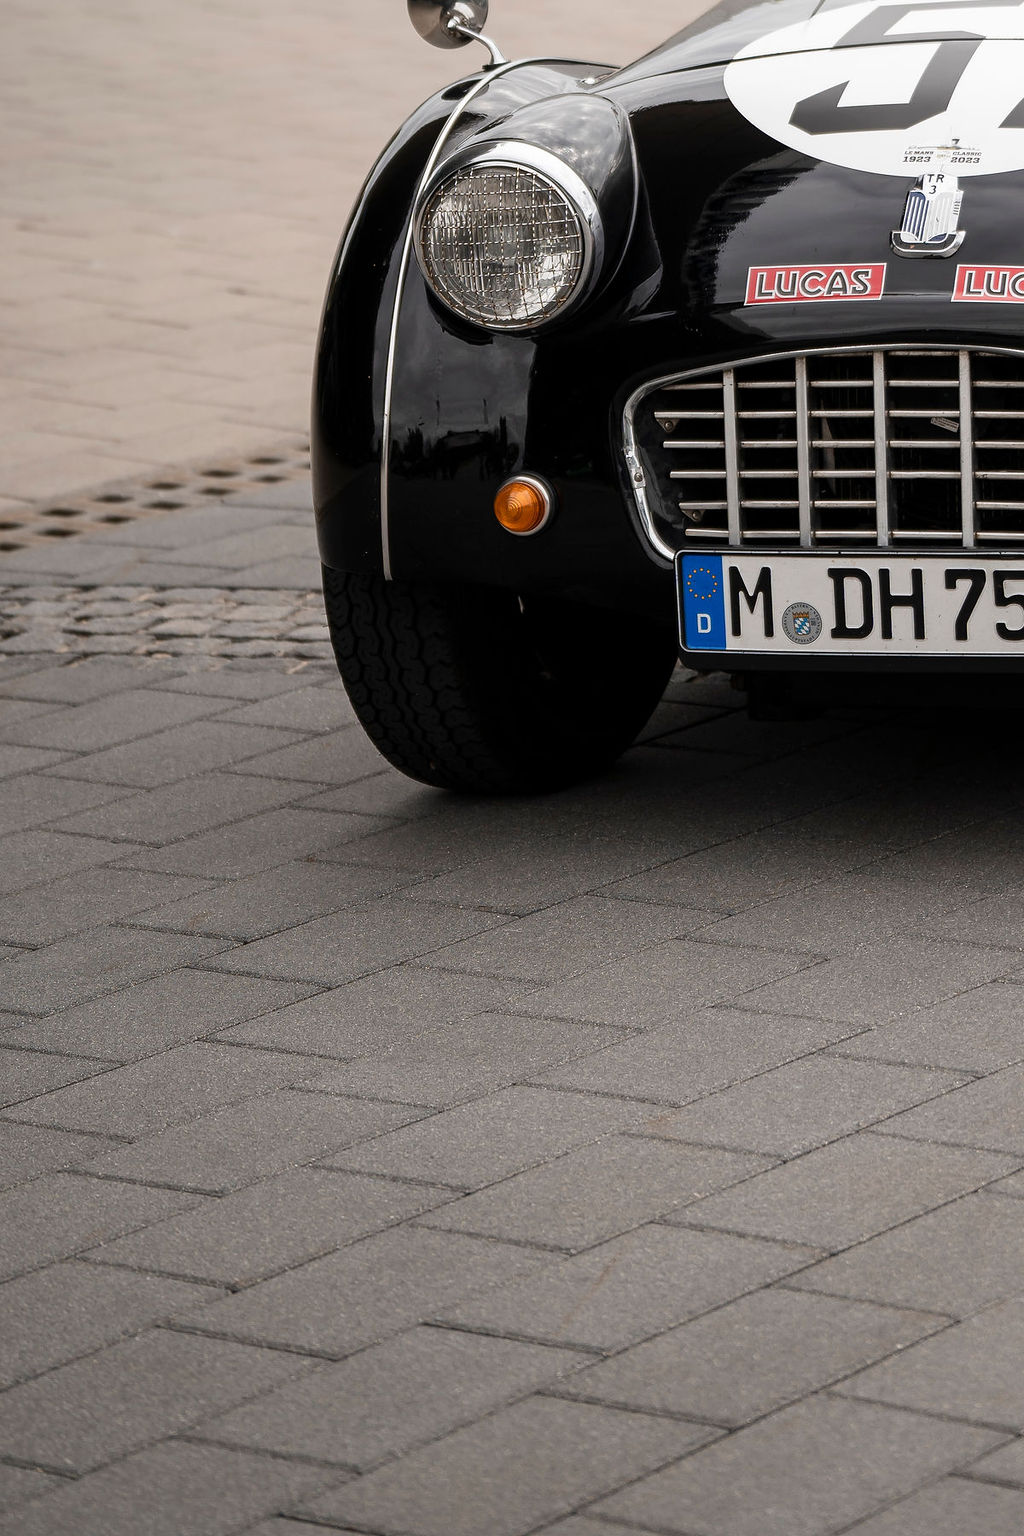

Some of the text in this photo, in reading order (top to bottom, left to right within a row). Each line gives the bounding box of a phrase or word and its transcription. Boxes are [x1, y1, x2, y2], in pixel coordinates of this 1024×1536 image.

[902, 155, 931, 163] 1923
[950, 156, 980, 164] 2023
[926, 173, 945, 183] TR
[928, 184, 938, 195] 3
[755, 268, 873, 300] LUCAS
[728, 565, 774, 637] M
[827, 567, 926, 640] DH
[696, 613, 712, 634] D
